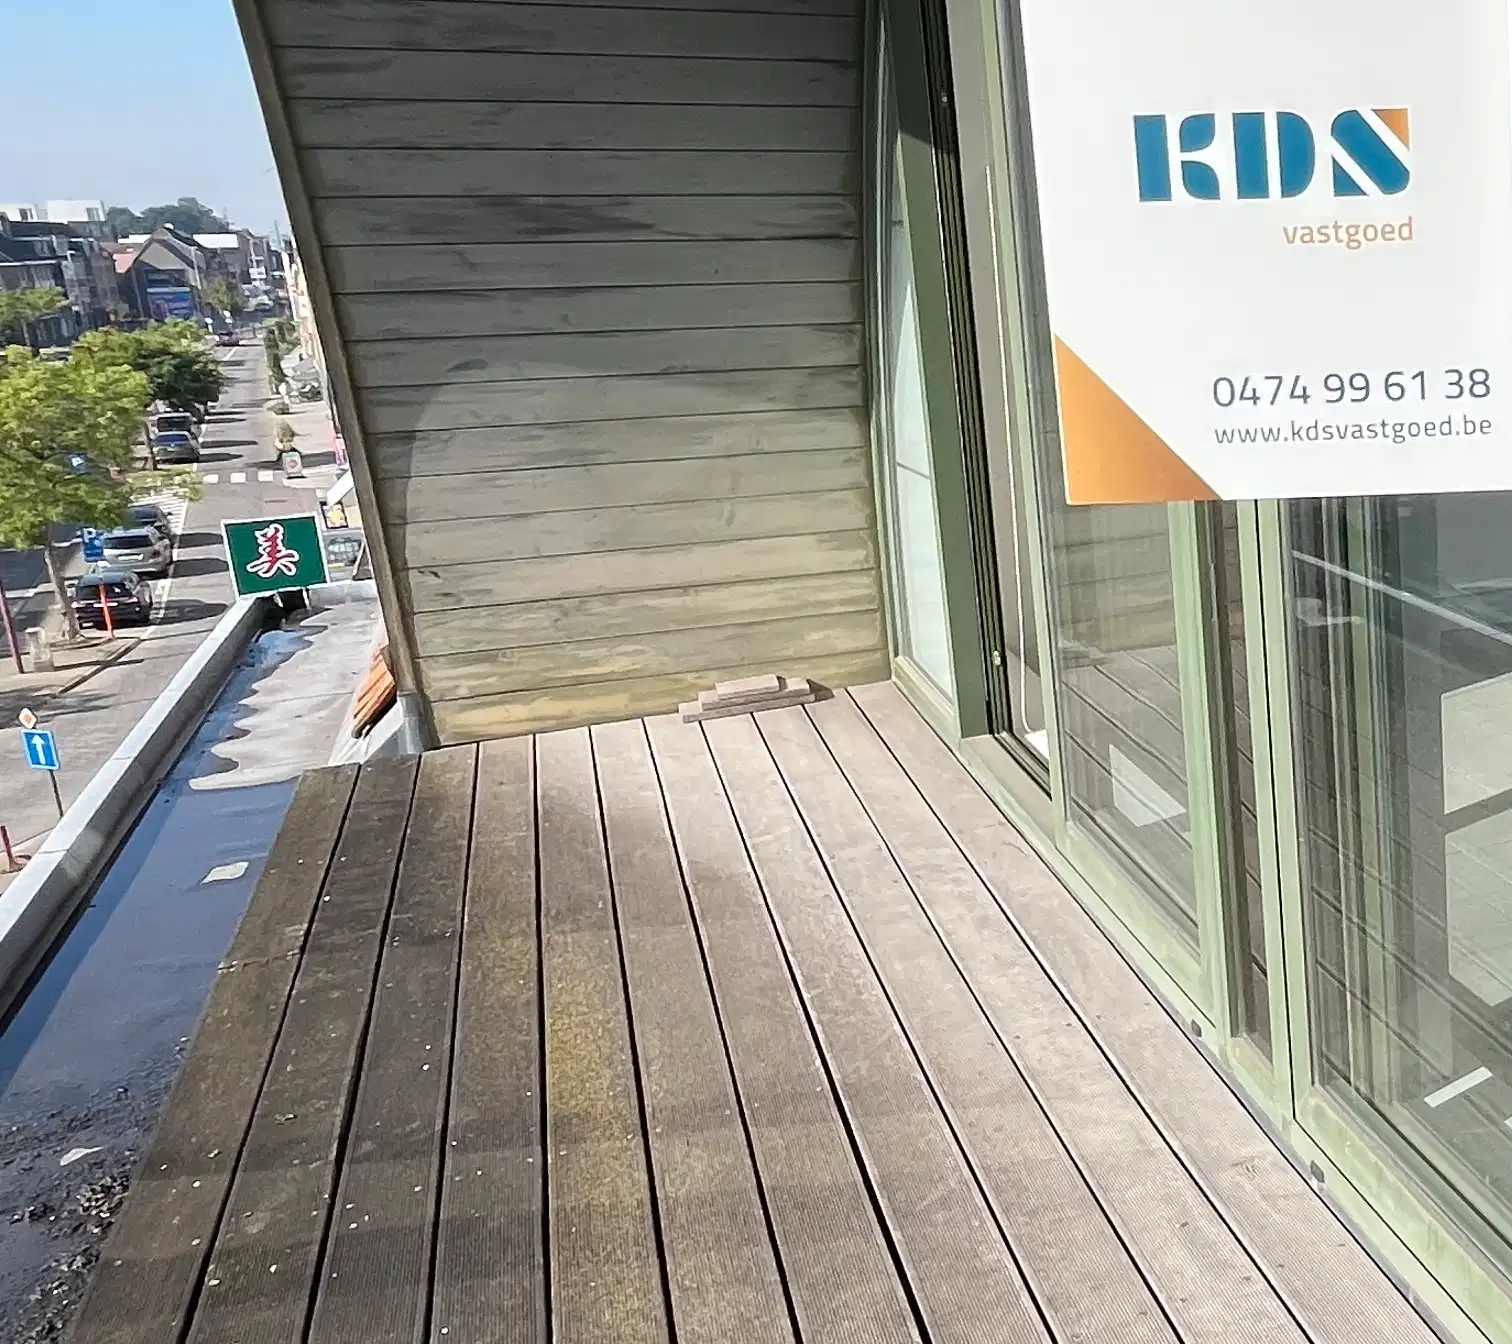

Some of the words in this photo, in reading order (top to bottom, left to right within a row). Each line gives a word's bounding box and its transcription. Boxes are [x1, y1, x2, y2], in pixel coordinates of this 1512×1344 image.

[1133, 108, 1411, 202] KDS
[1282, 216, 1413, 250] vastgoed
[1213, 375, 1311, 407] 0474
[1323, 372, 1370, 404] 99
[1384, 370, 1426, 401] 61
[1444, 368, 1491, 400] 38
[1214, 414, 1493, 444] www.kdsvastgoed.be
[246, 523, 299, 577] 美
